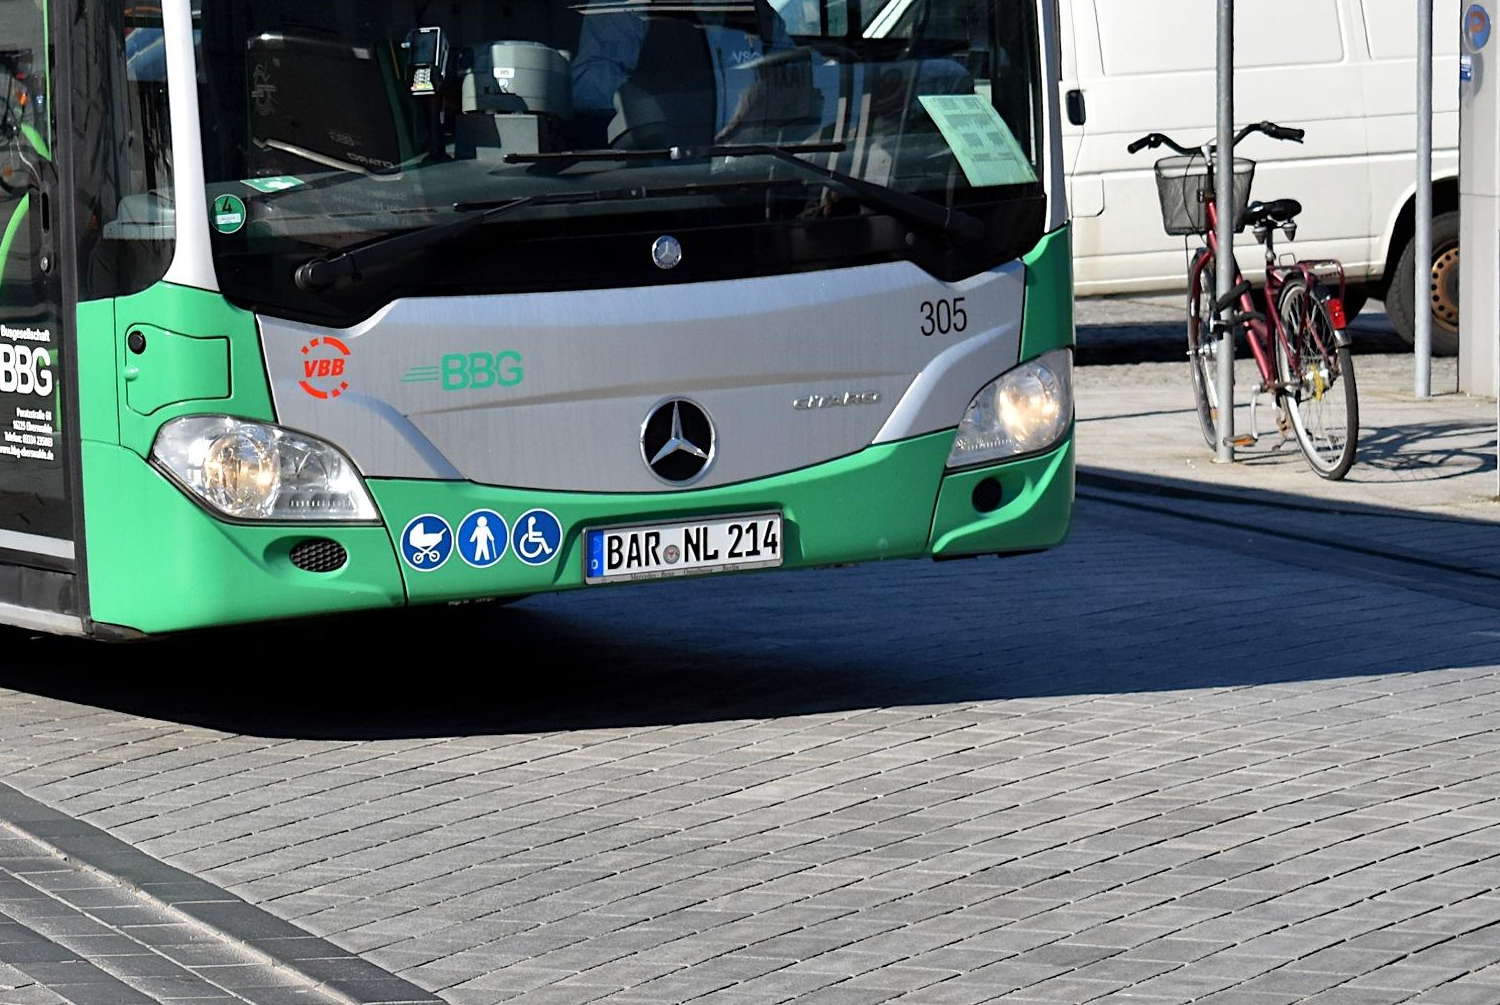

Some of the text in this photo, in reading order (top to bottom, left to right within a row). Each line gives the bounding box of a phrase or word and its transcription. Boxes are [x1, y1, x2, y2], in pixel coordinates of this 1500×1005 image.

[222, 197, 233, 213] 4
[920, 298, 967, 336] 305
[302, 355, 345, 379] VBB
[441, 350, 524, 391] BBG
[607, 520, 778, 570] BAR NL 214
